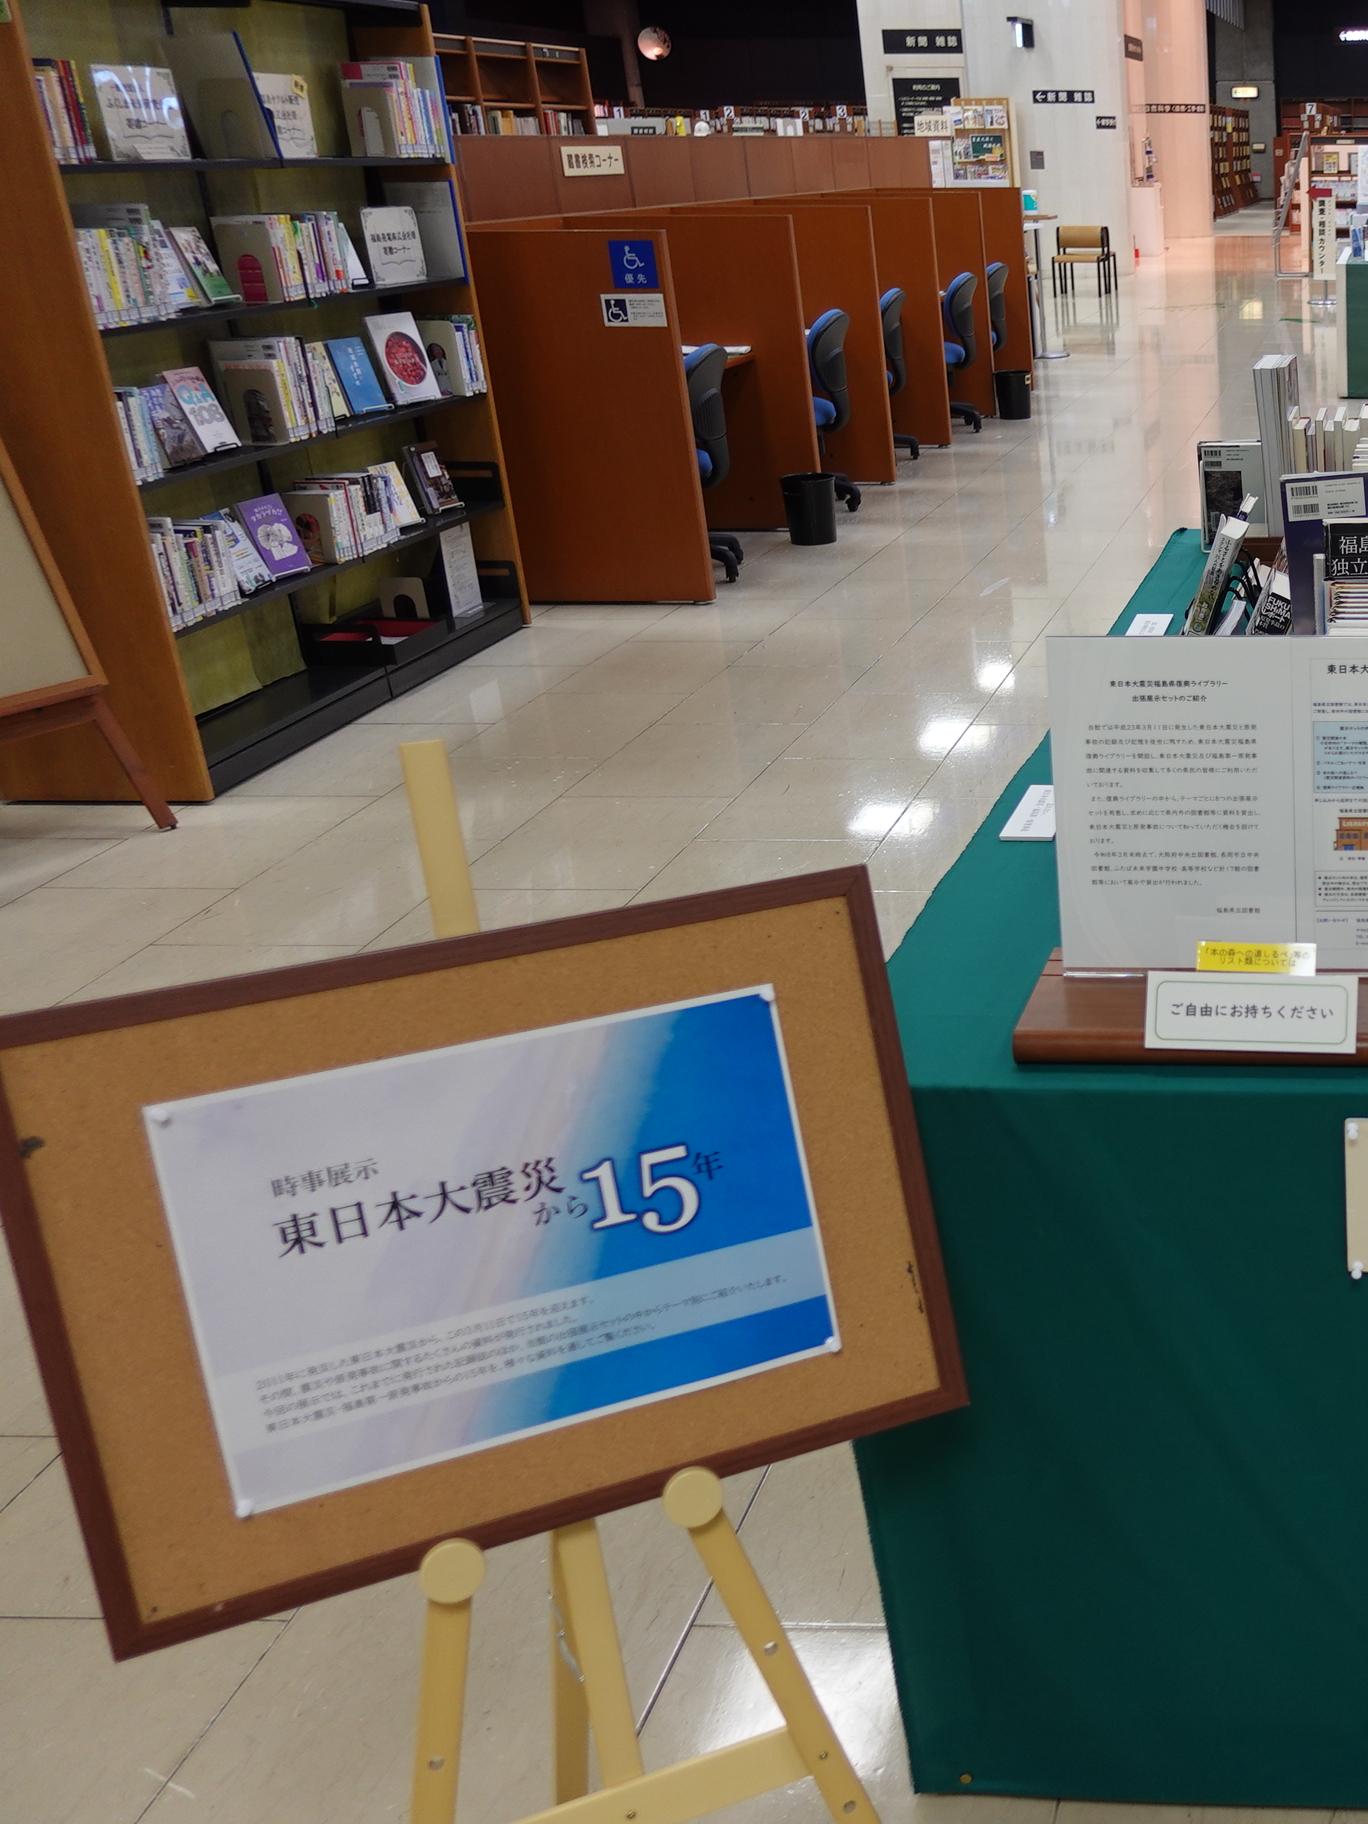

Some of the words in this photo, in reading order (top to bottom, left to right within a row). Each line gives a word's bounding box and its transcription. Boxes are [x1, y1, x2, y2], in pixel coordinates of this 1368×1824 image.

[725, 107, 733, 118] 2
[801, 110, 808, 120] 2
[1307, 104, 1314, 114] 7
[624, 273, 648, 285] 優先
[1170, 1002, 1335, 1021] ご自由にお持ちください
[270, 1158, 379, 1198] 時事展示
[273, 1156, 566, 1260] 東日本大震災
[534, 1194, 589, 1227] から
[583, 1145, 701, 1234] 15
[693, 1151, 725, 1183] 年
